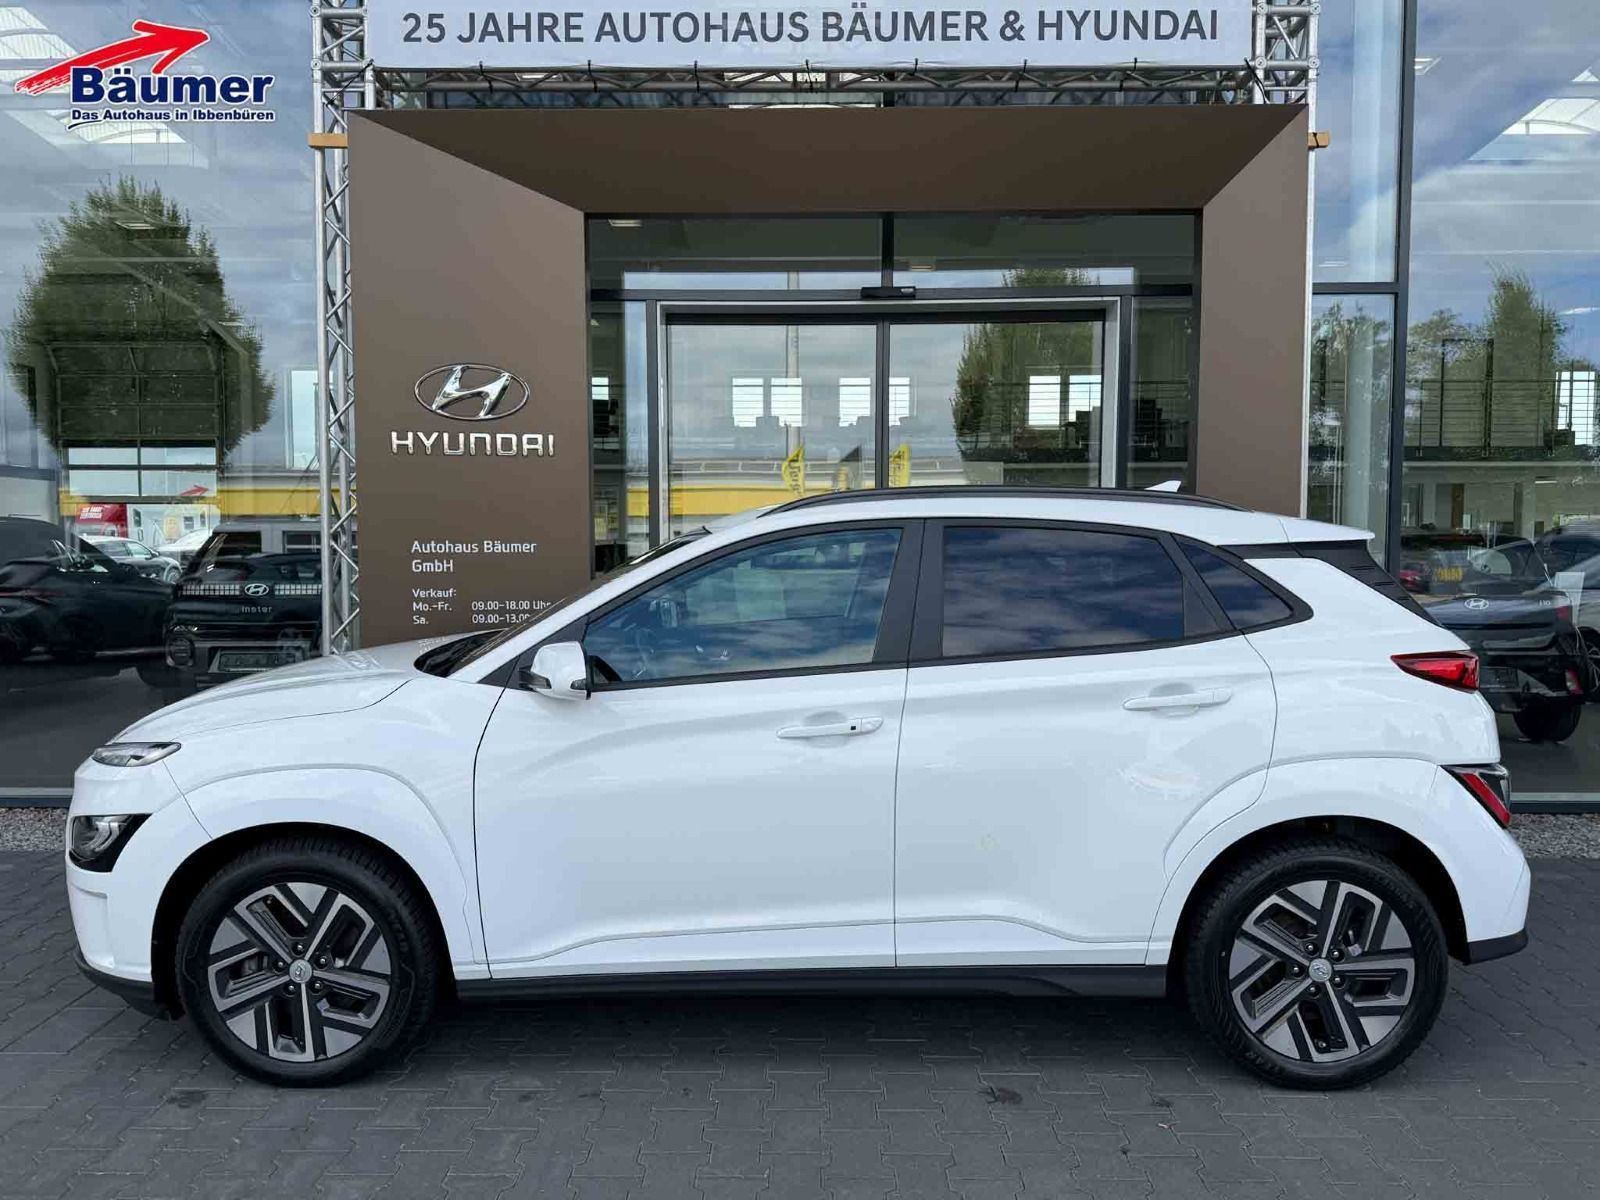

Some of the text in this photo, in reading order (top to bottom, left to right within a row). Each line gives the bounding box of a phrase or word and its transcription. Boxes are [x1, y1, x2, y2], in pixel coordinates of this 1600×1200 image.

[402, 2, 1218, 43] 25 JAHRE AUTOHAUS BÄUMER & HYUNDAI
[391, 430, 555, 456] HYUNDAI
[411, 540, 537, 553] Autohaus Bäumer
[412, 559, 454, 572] GmbH
[412, 588, 457, 598] Verkauf:
[413, 615, 429, 625] Sa.
